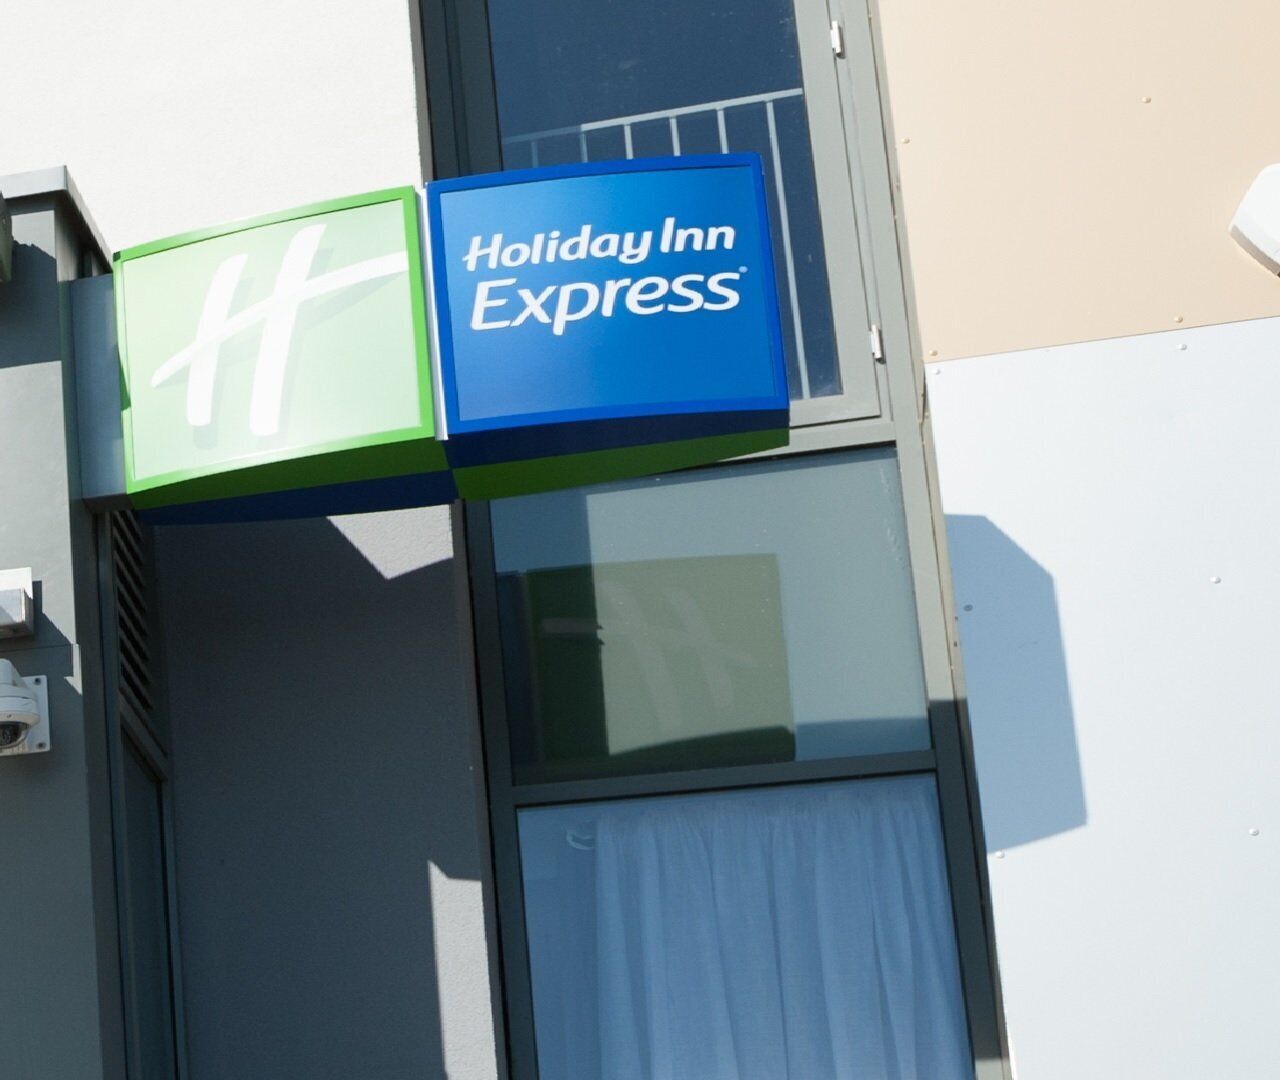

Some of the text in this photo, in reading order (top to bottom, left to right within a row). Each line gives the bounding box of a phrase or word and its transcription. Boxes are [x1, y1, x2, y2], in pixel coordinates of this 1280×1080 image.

[462, 217, 735, 272] Holiday Inn
[470, 272, 740, 336] Express
